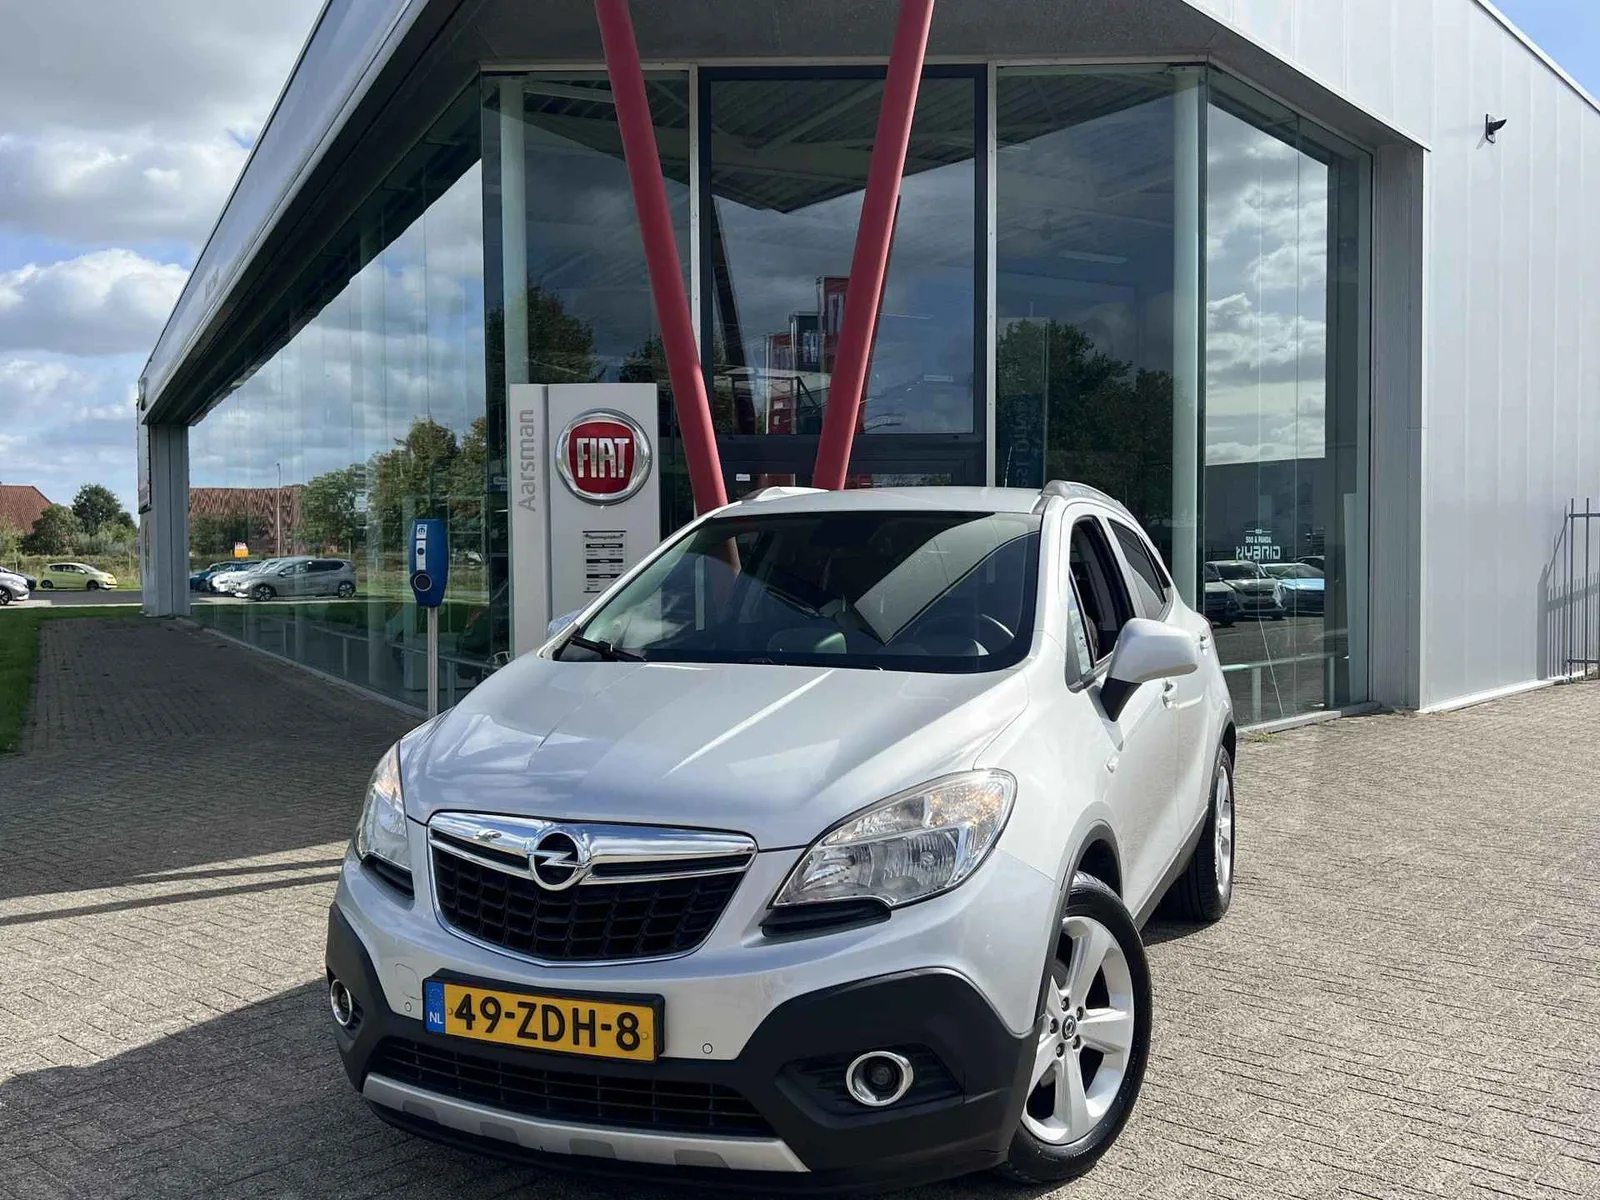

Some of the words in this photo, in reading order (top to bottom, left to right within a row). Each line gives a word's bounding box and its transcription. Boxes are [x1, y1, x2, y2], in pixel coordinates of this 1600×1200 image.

[519, 409, 536, 511] Aarsman
[576, 437, 630, 478] FIAT
[1236, 546, 1280, 560] HYBRID
[429, 1012, 444, 1025] NL
[454, 993, 640, 1051] 49-ZDH-8
